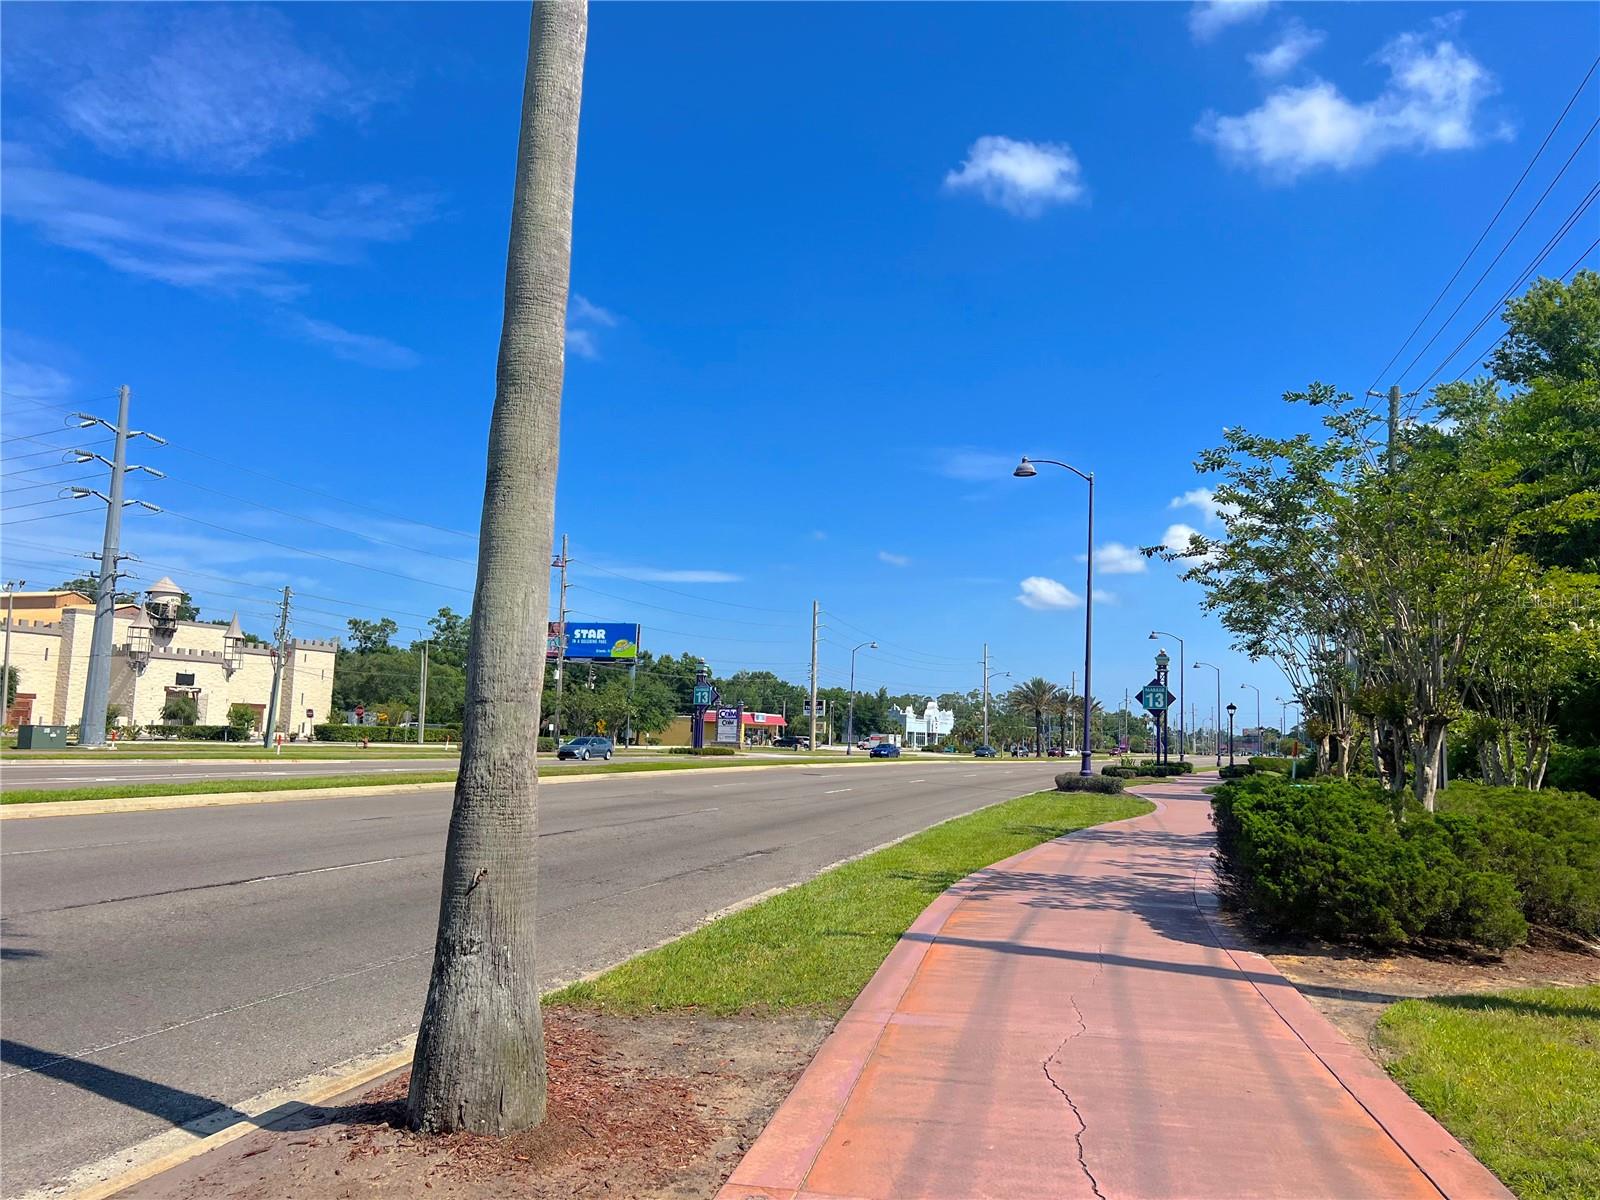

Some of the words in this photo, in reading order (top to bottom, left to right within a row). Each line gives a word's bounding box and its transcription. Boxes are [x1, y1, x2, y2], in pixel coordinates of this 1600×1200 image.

[574, 629, 606, 639] STAR
[696, 691, 708, 703] 13
[1146, 692, 1164, 707] 13
